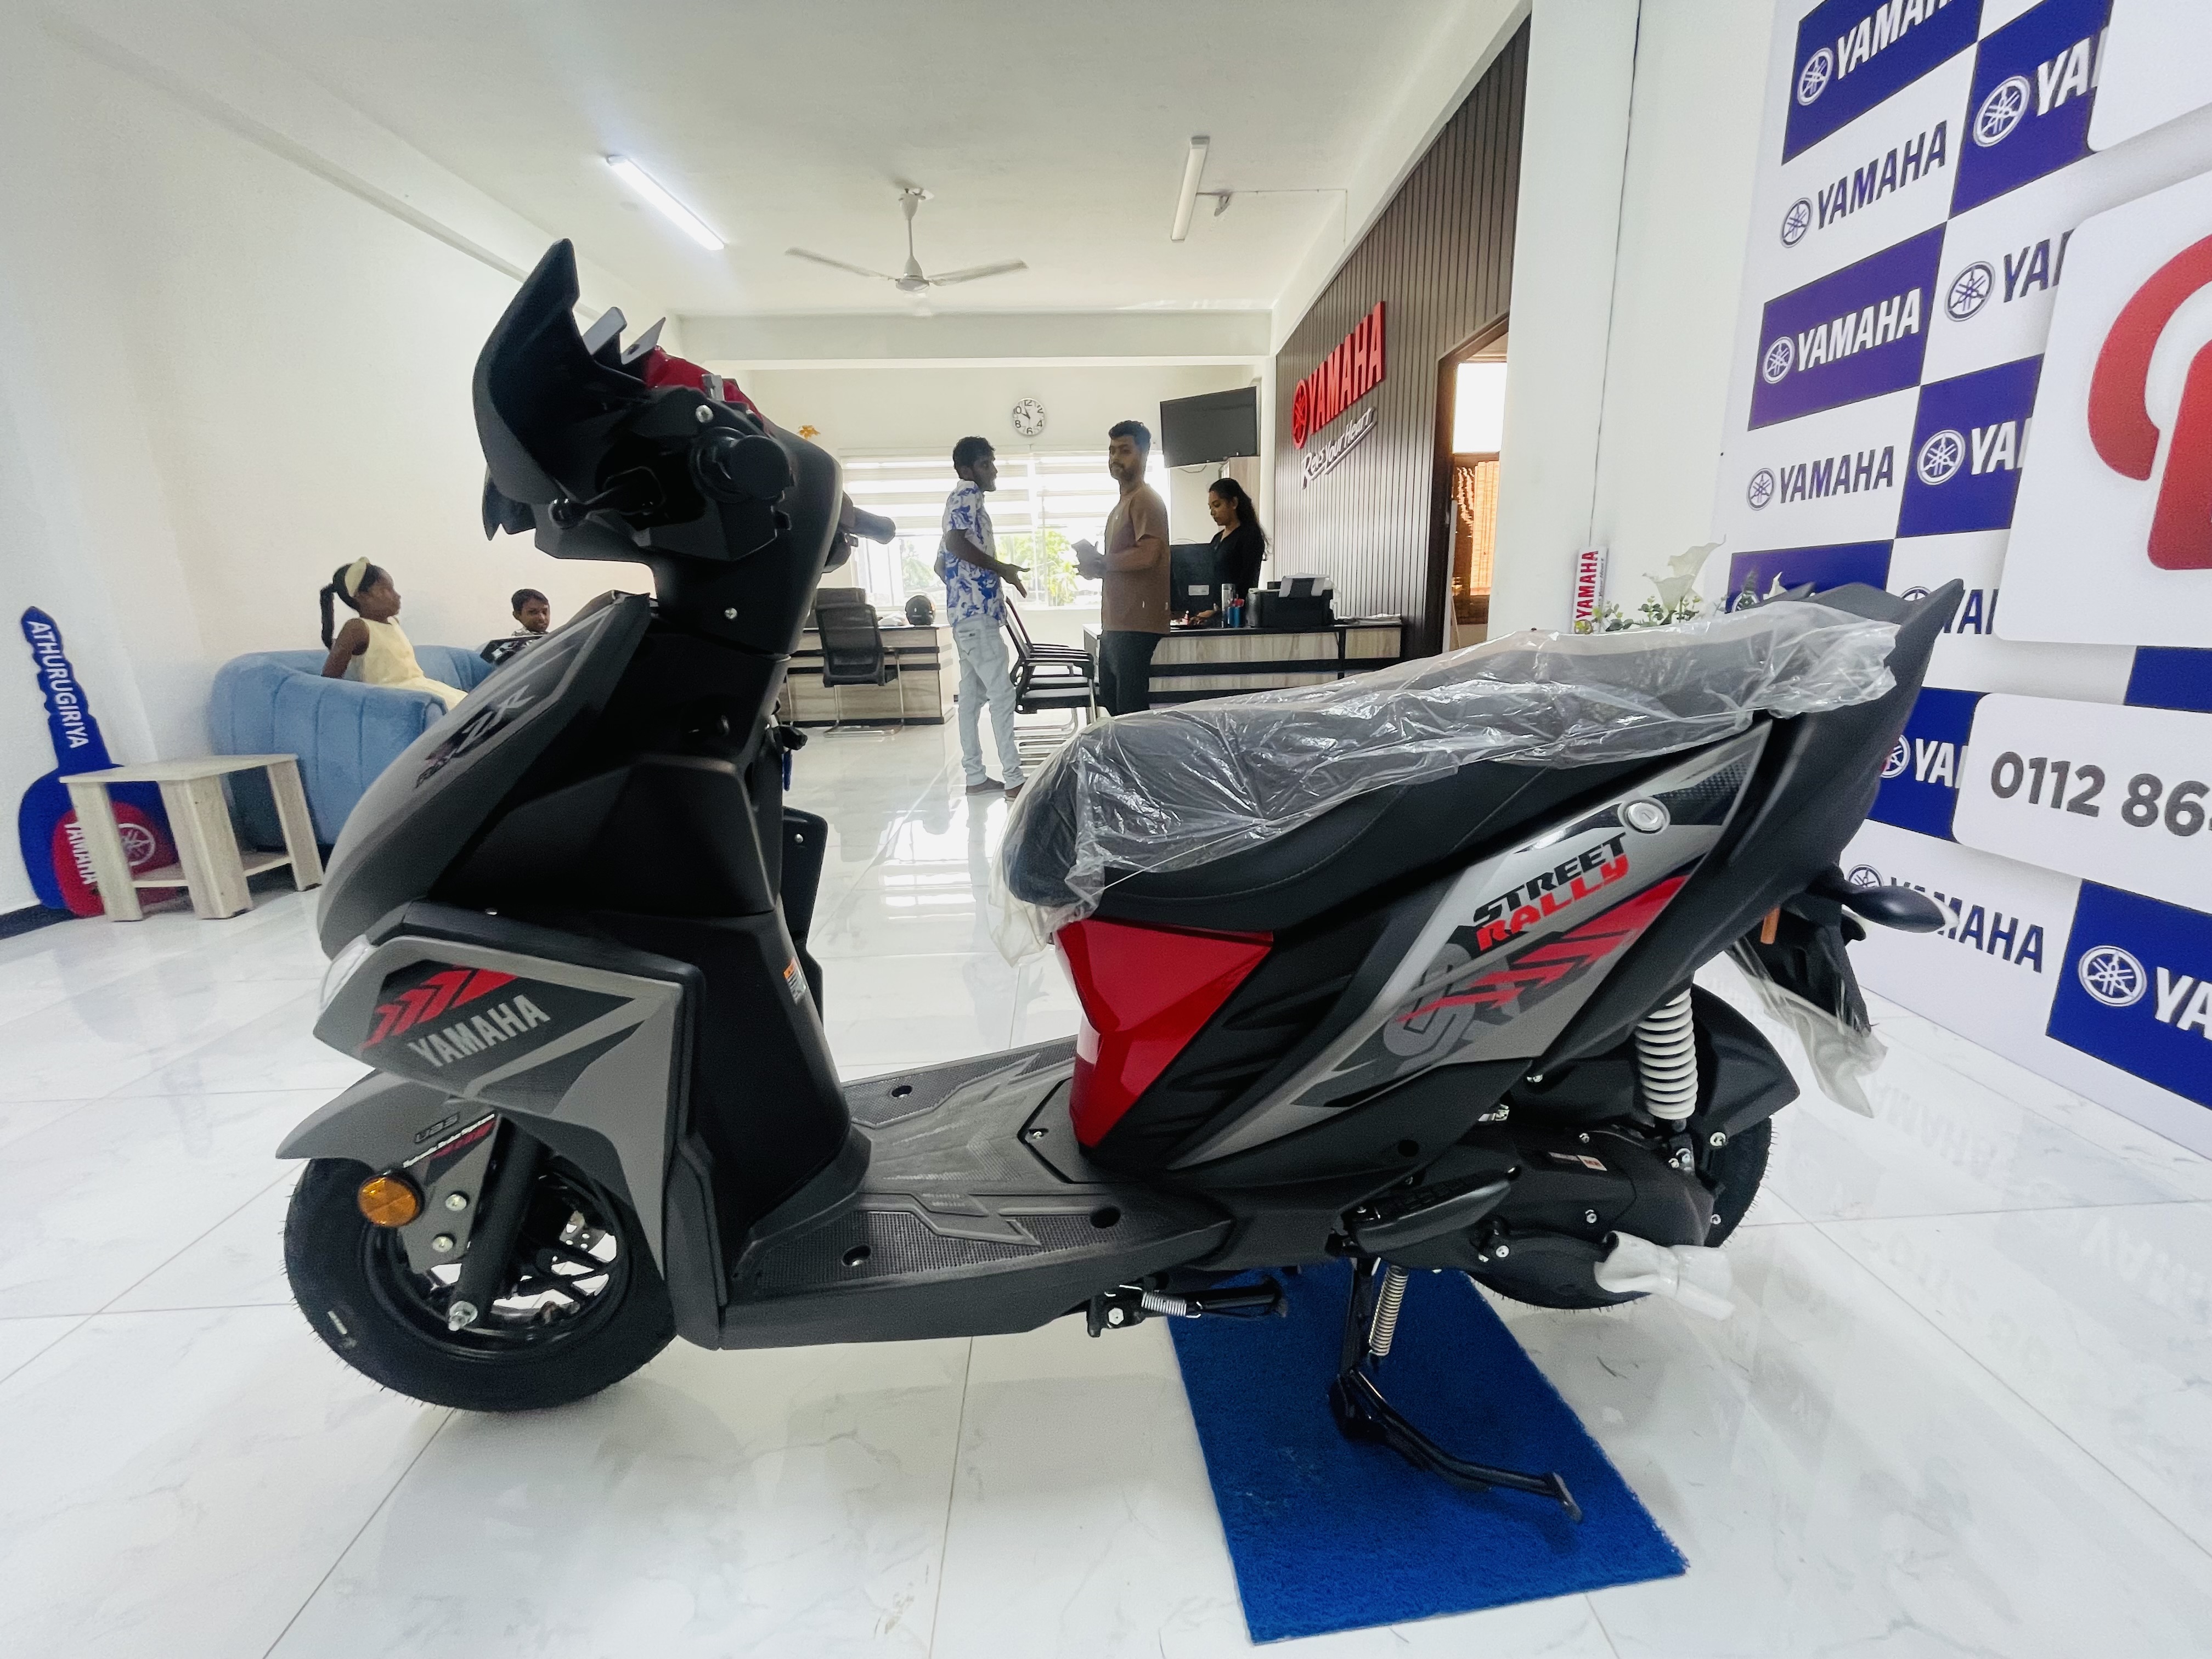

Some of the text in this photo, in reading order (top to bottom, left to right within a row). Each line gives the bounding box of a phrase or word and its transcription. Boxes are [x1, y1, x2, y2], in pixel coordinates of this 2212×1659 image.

[1838, 0, 1953, 80] YAMA
[1818, 120, 1946, 229] YAMAHA
[1308, 301, 1385, 435] YAMAHA
[1798, 287, 1920, 371] YAMAHA
[1324, 441, 1345, 472] Your
[1344, 407, 1373, 448] Heart
[1780, 445, 1894, 498] YAMAHA
[1576, 551, 1599, 618] YAMAHA
[27, 620, 89, 749] ATHURUGIRIYA
[1991, 751, 2212, 837] 0112 86
[1474, 832, 1626, 927] STREET
[407, 995, 550, 1067] YAMAHA
